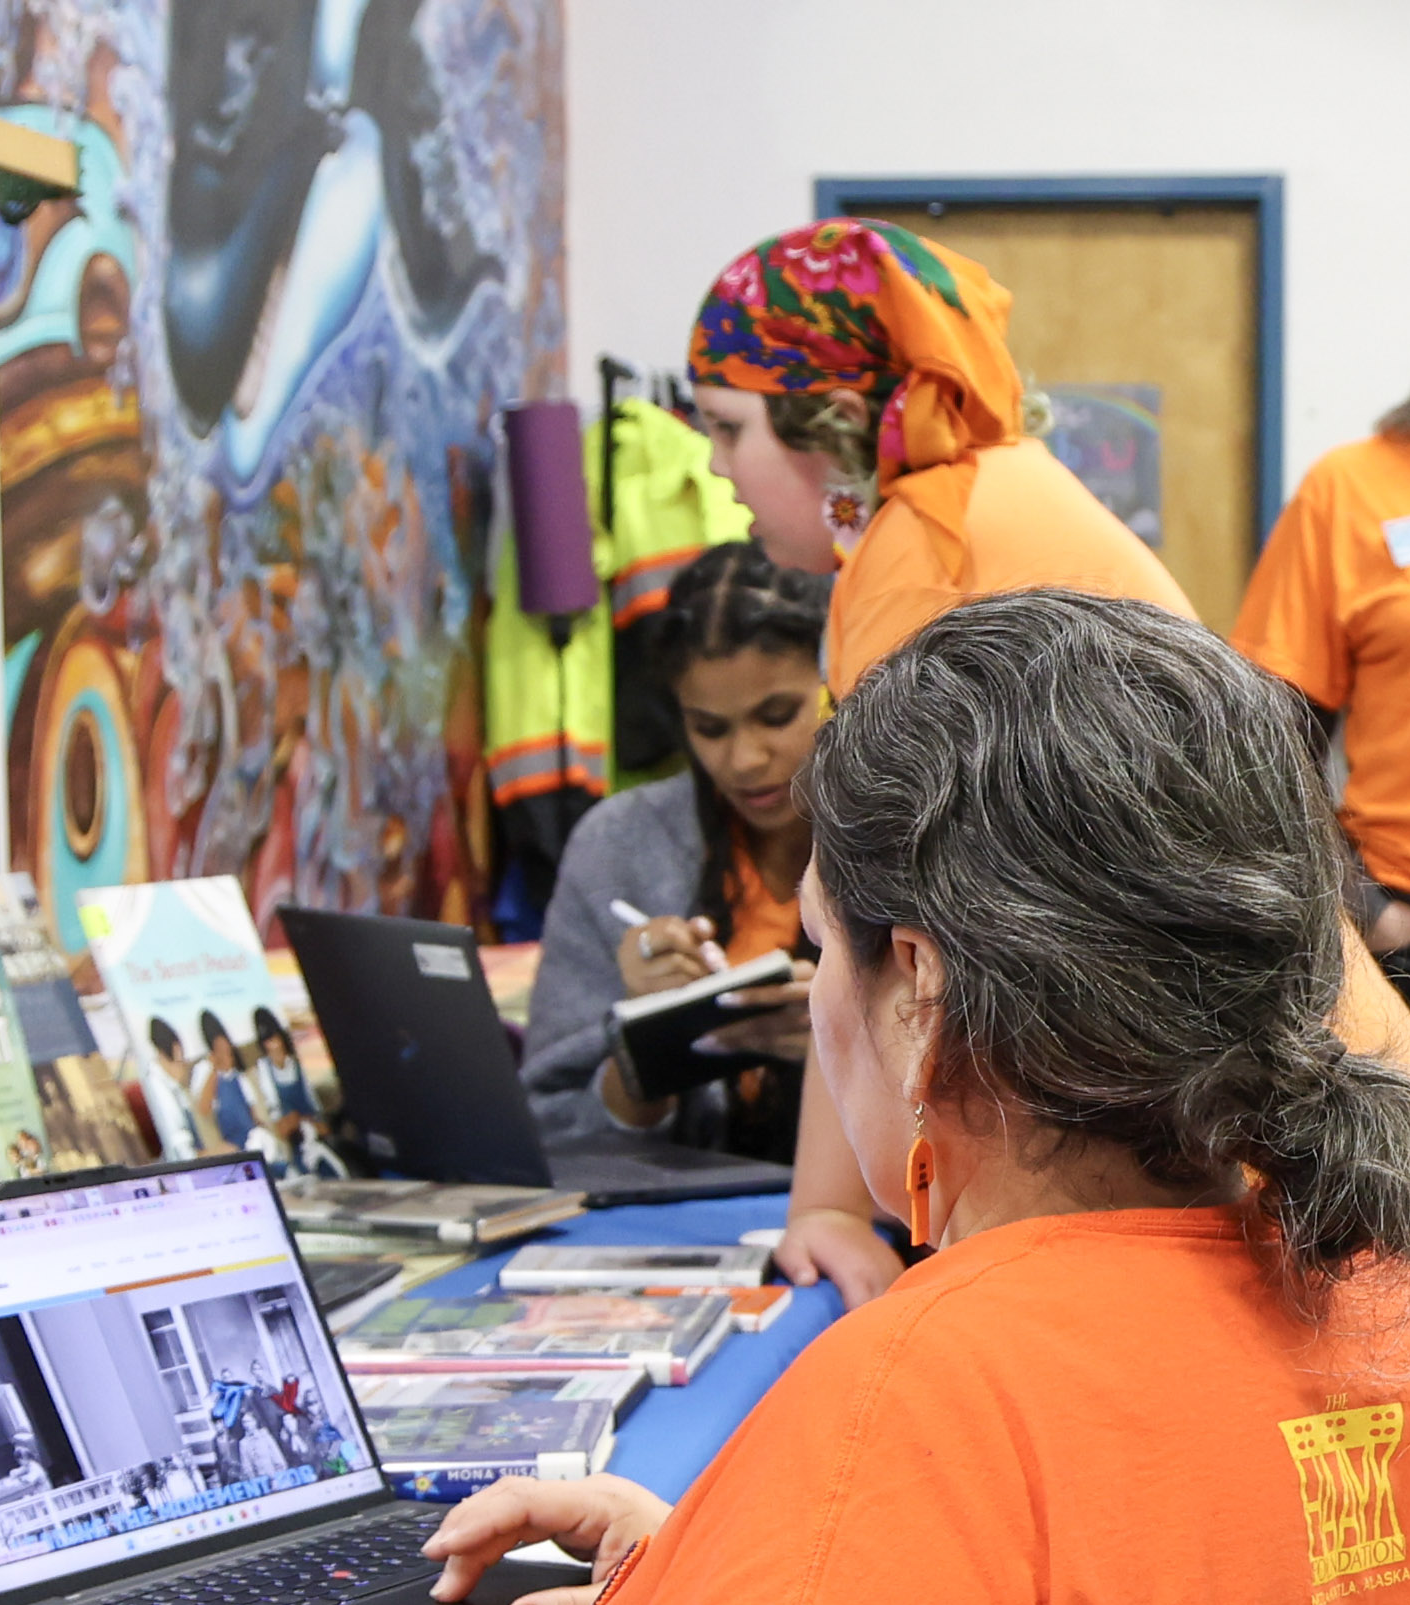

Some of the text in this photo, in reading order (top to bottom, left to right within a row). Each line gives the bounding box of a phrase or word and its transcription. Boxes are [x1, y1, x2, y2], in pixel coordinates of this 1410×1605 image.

[1325, 1391, 1349, 1412] THE
[447, 1465, 539, 1481] MONA SUSA
